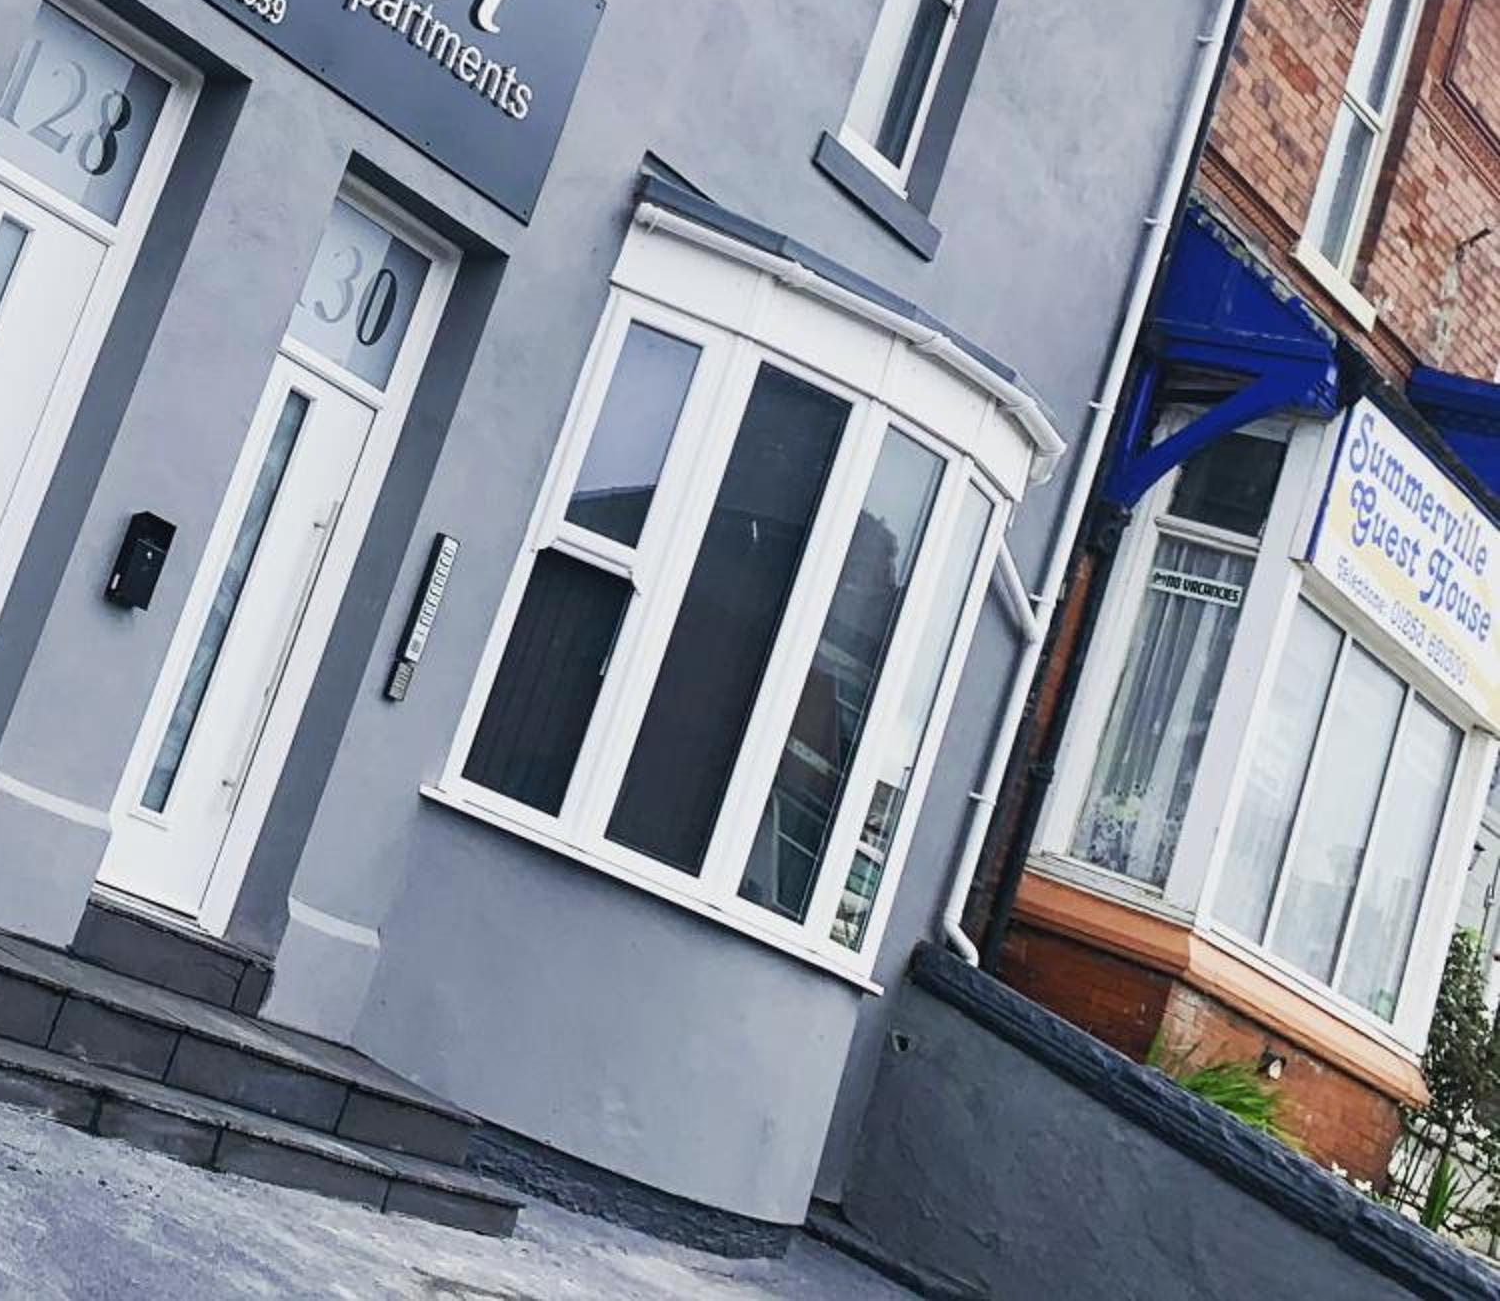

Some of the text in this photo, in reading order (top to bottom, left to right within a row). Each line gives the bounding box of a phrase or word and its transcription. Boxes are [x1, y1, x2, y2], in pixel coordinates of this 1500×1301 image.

[298, 245, 398, 347] 30
[1350, 413, 1488, 576] Summerville
[1351, 479, 1492, 642] Guest House
[1183, 578, 1240, 603] VACANCIES
